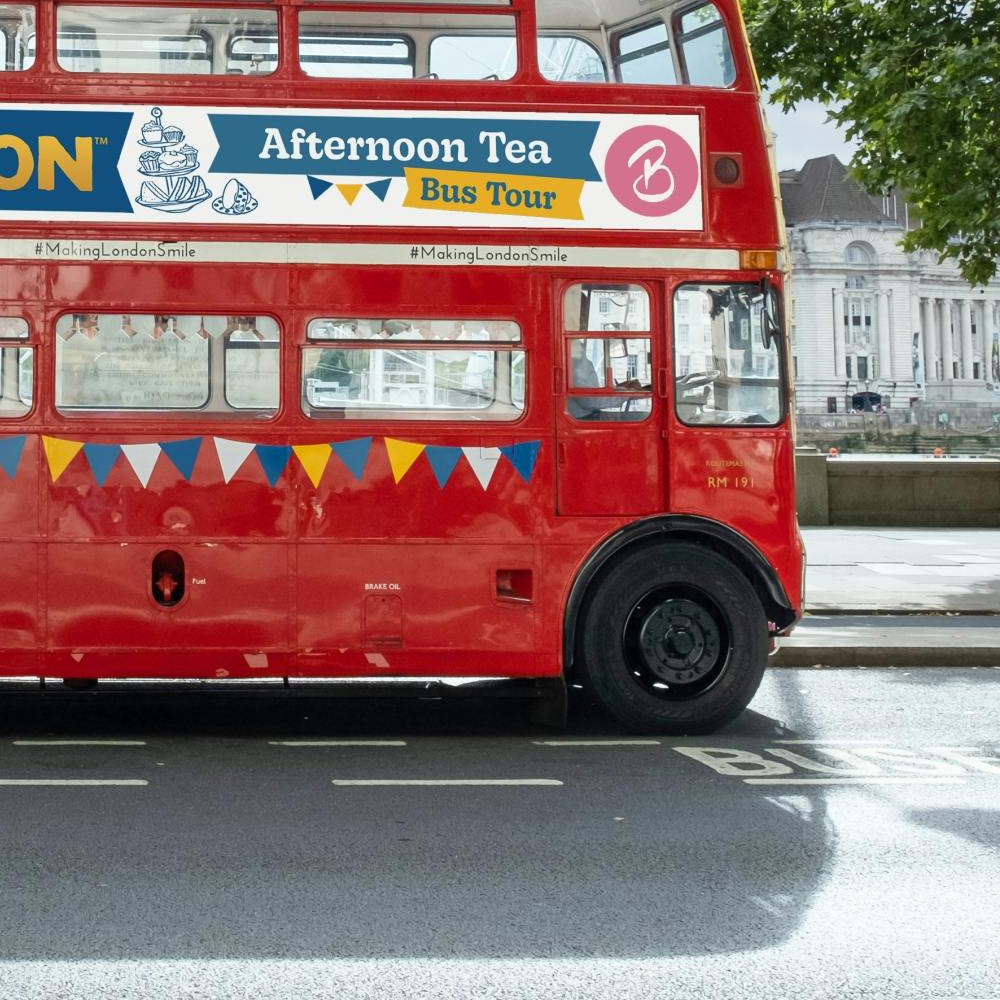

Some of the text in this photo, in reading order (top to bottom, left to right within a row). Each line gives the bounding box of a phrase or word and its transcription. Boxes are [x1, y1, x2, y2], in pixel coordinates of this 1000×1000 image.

[258, 127, 552, 165] Afternoon Tea
[627, 138, 675, 203] B
[420, 177, 557, 210] Bus Tour
[34, 242, 196, 261] #MakingLondonSmile
[410, 246, 568, 265] #MakingLondonSmile
[707, 476, 754, 488] RM 191
[191, 577, 206, 585] Fuel
